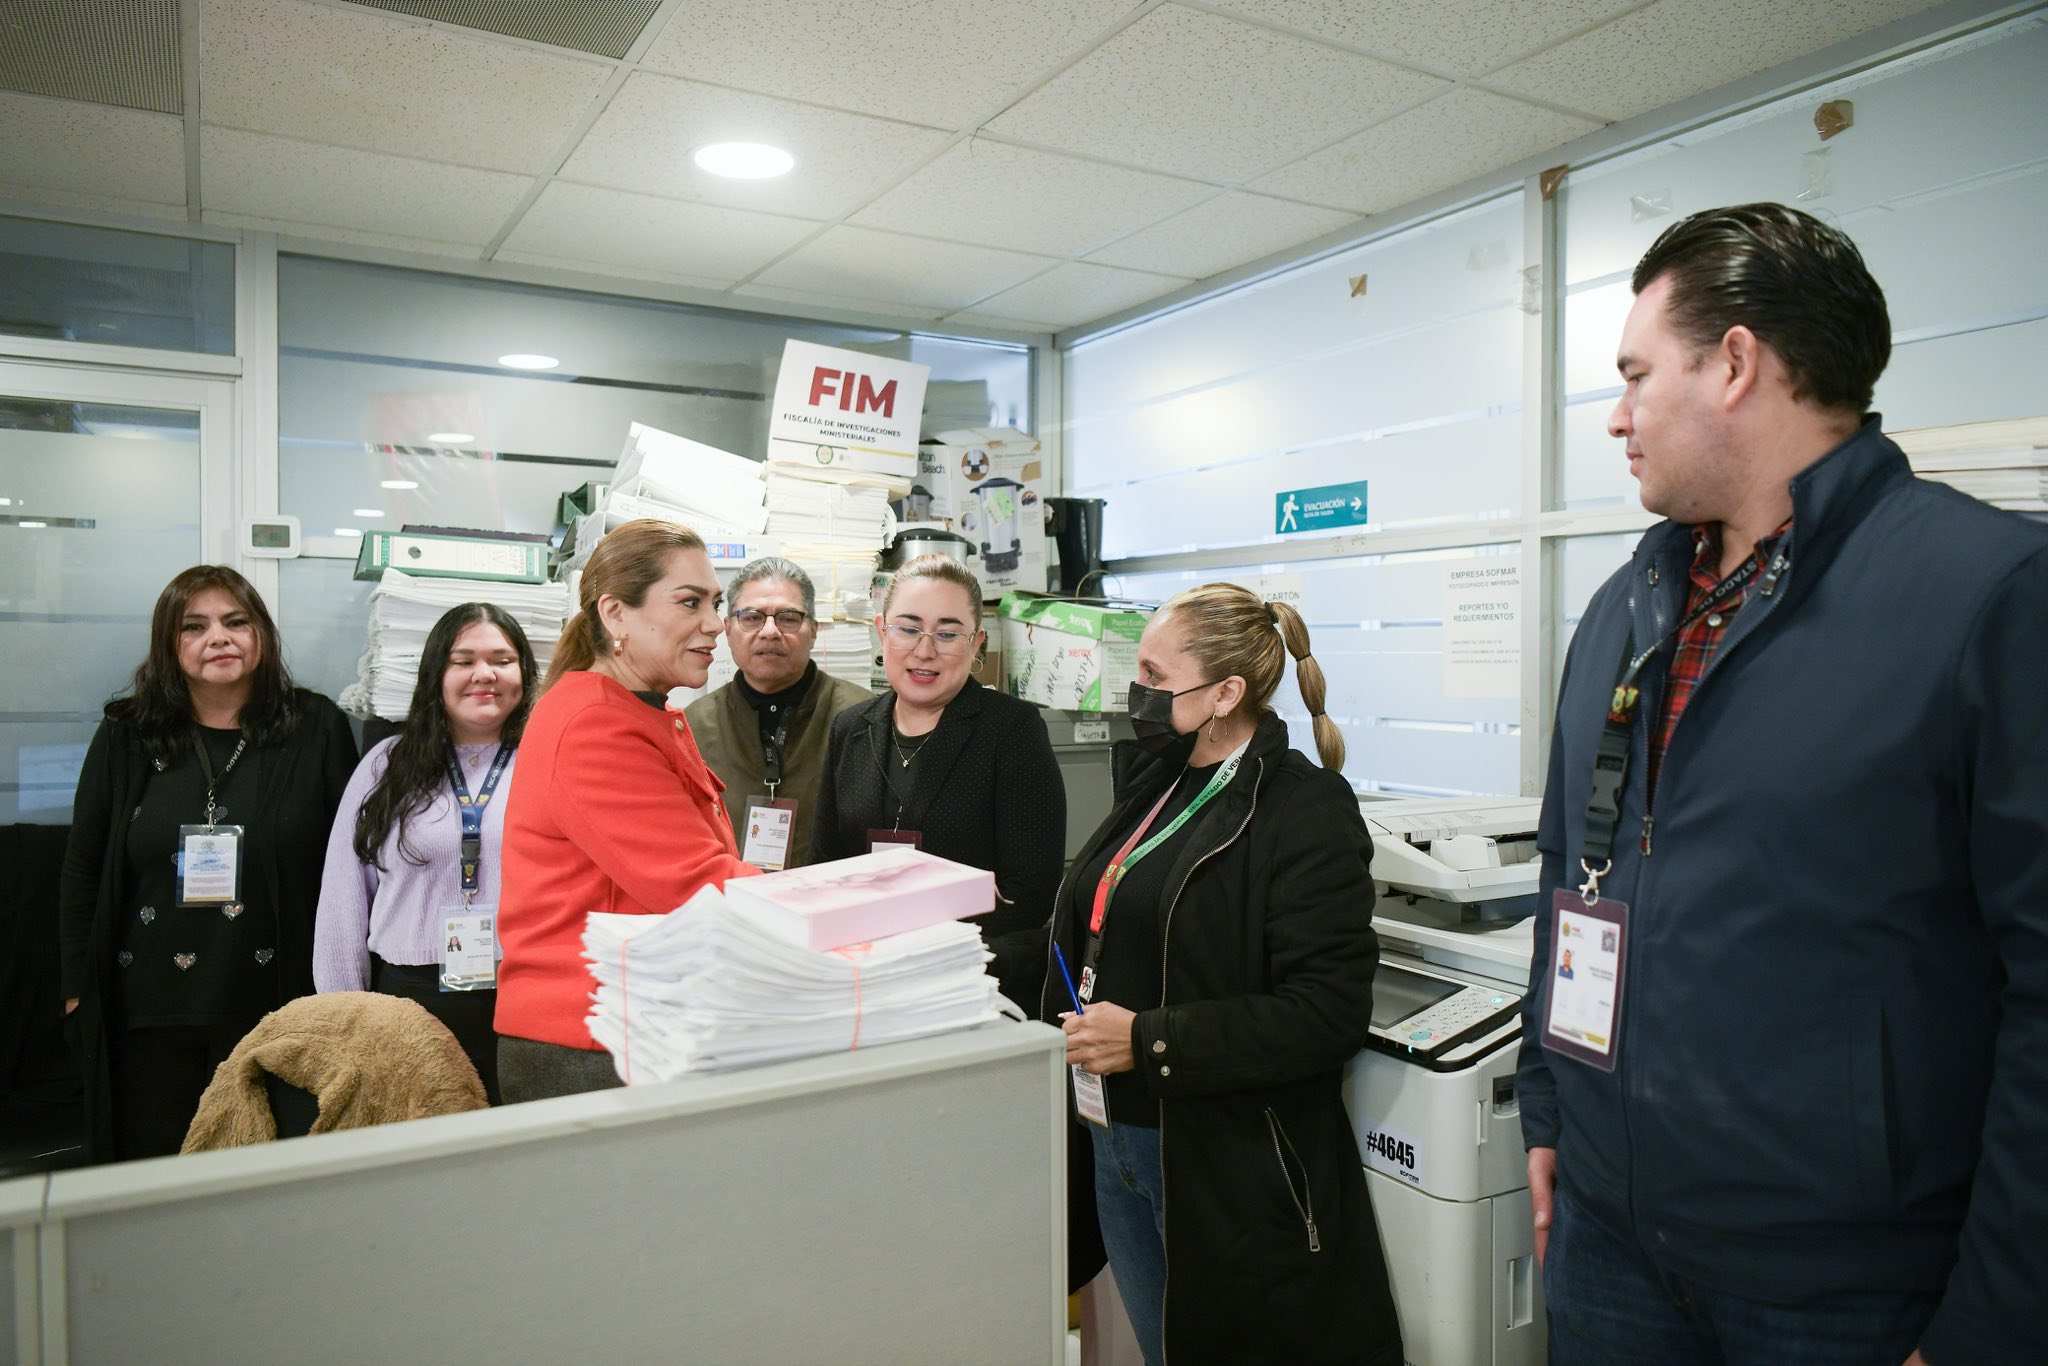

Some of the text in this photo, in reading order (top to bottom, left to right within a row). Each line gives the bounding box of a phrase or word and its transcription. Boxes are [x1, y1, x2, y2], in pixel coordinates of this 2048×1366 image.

[808, 366, 898, 418] FIM
[783, 413, 823, 425] FISCALÍA
[836, 422, 901, 438] INVESTIGACIONES
[819, 429, 876, 443] MINISTERIALES
[922, 462, 945, 474] Beach
[1303, 499, 1346, 512] EVACUACIÓN
[1450, 567, 1517, 580] EMPRESA SOFMAR
[1458, 602, 1495, 612] REPORTES
[1453, 612, 1514, 622] REQUERIMIENTOS
[1068, 648, 1092, 657] xerox
[226, 739, 247, 772] ESTADO
[1200, 780, 1223, 802] ESTADO
[1221, 770, 1231, 781] DE
[1366, 1130, 1415, 1170] #4645
